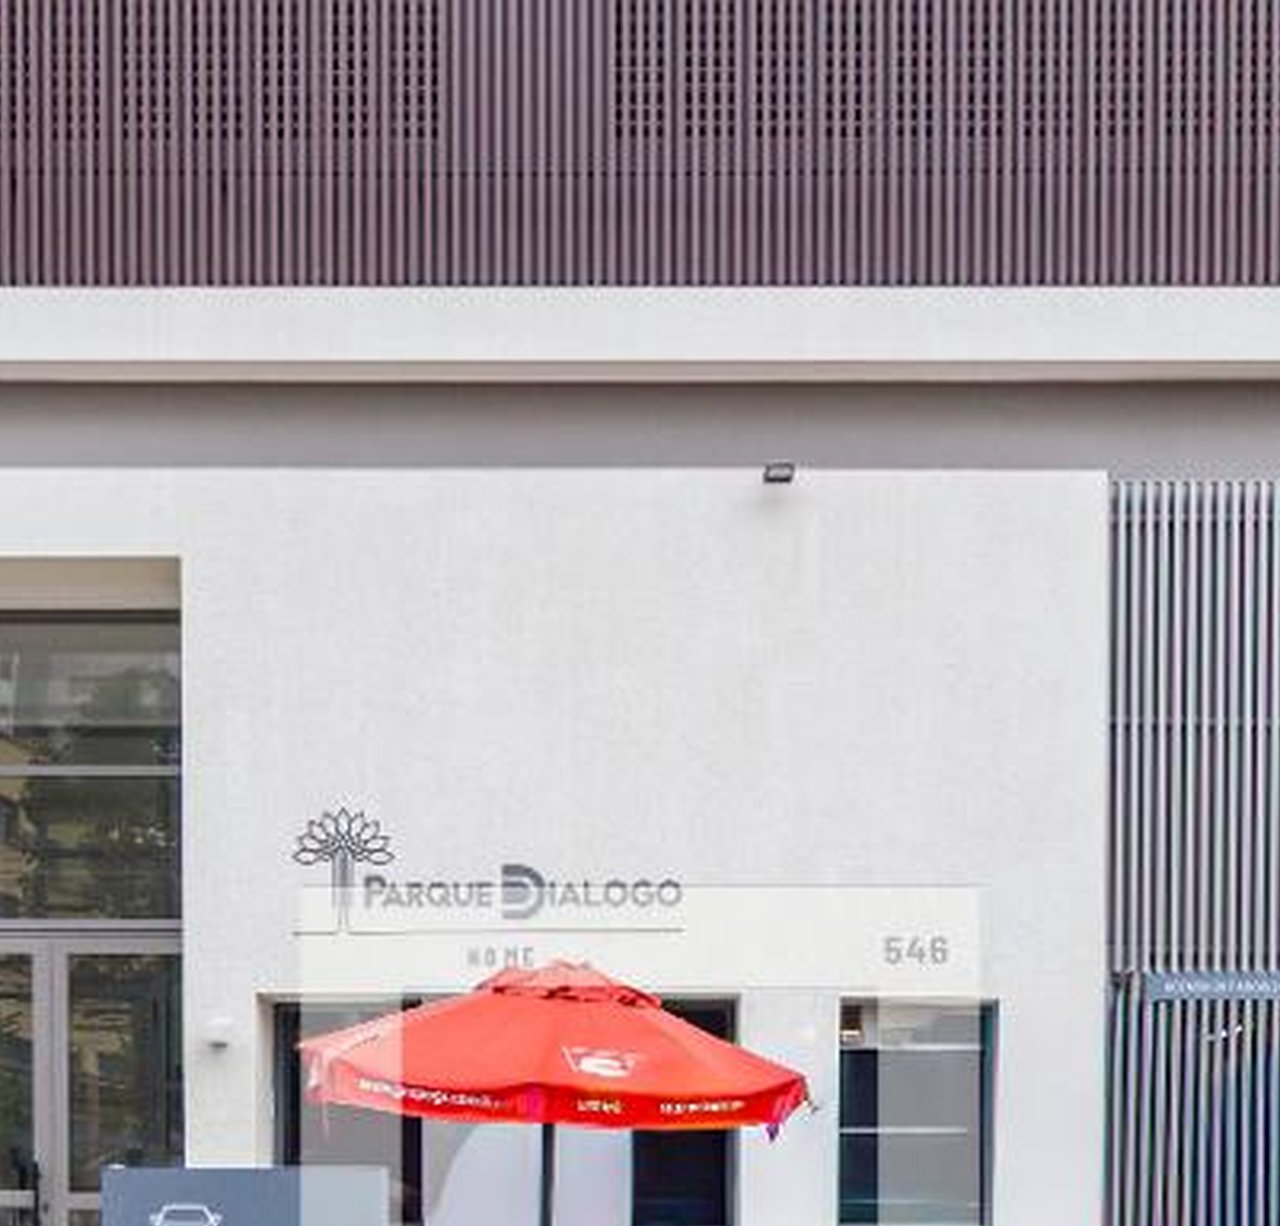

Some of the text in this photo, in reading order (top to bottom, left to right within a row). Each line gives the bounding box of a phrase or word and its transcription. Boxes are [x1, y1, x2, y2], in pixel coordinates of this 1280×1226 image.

[363, 863, 683, 920] PARQUE DIALOGO
[883, 936, 948, 965] 546
